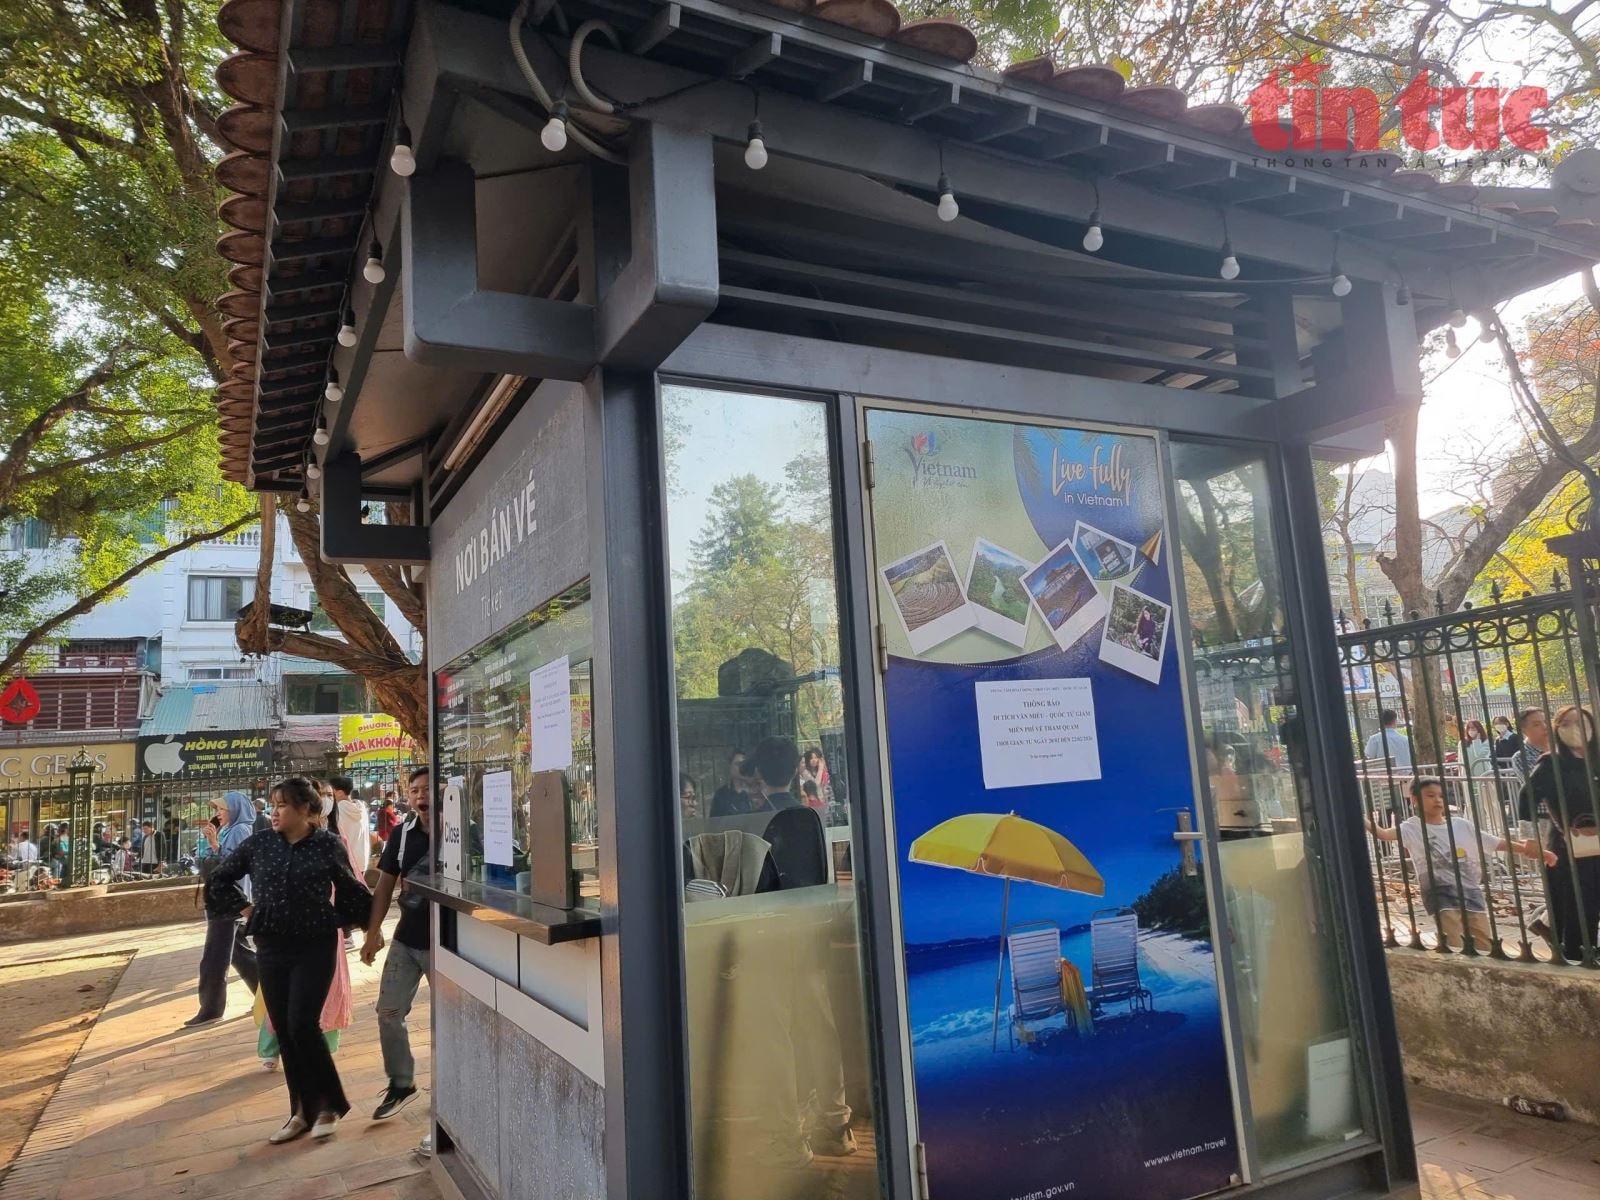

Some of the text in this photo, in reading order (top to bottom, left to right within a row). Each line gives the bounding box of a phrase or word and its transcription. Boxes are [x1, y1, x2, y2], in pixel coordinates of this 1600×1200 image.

[1052, 442, 1131, 507] Live fully
[1064, 492, 1124, 507] in Vietnam
[455, 469, 537, 595] NƠI BÁN VÉ
[480, 586, 502, 619] Ticket
[1023, 699, 1046, 708] THÔNG
[184, 736, 268, 751] HỒNG PHÁT
[444, 821, 460, 843] Close
